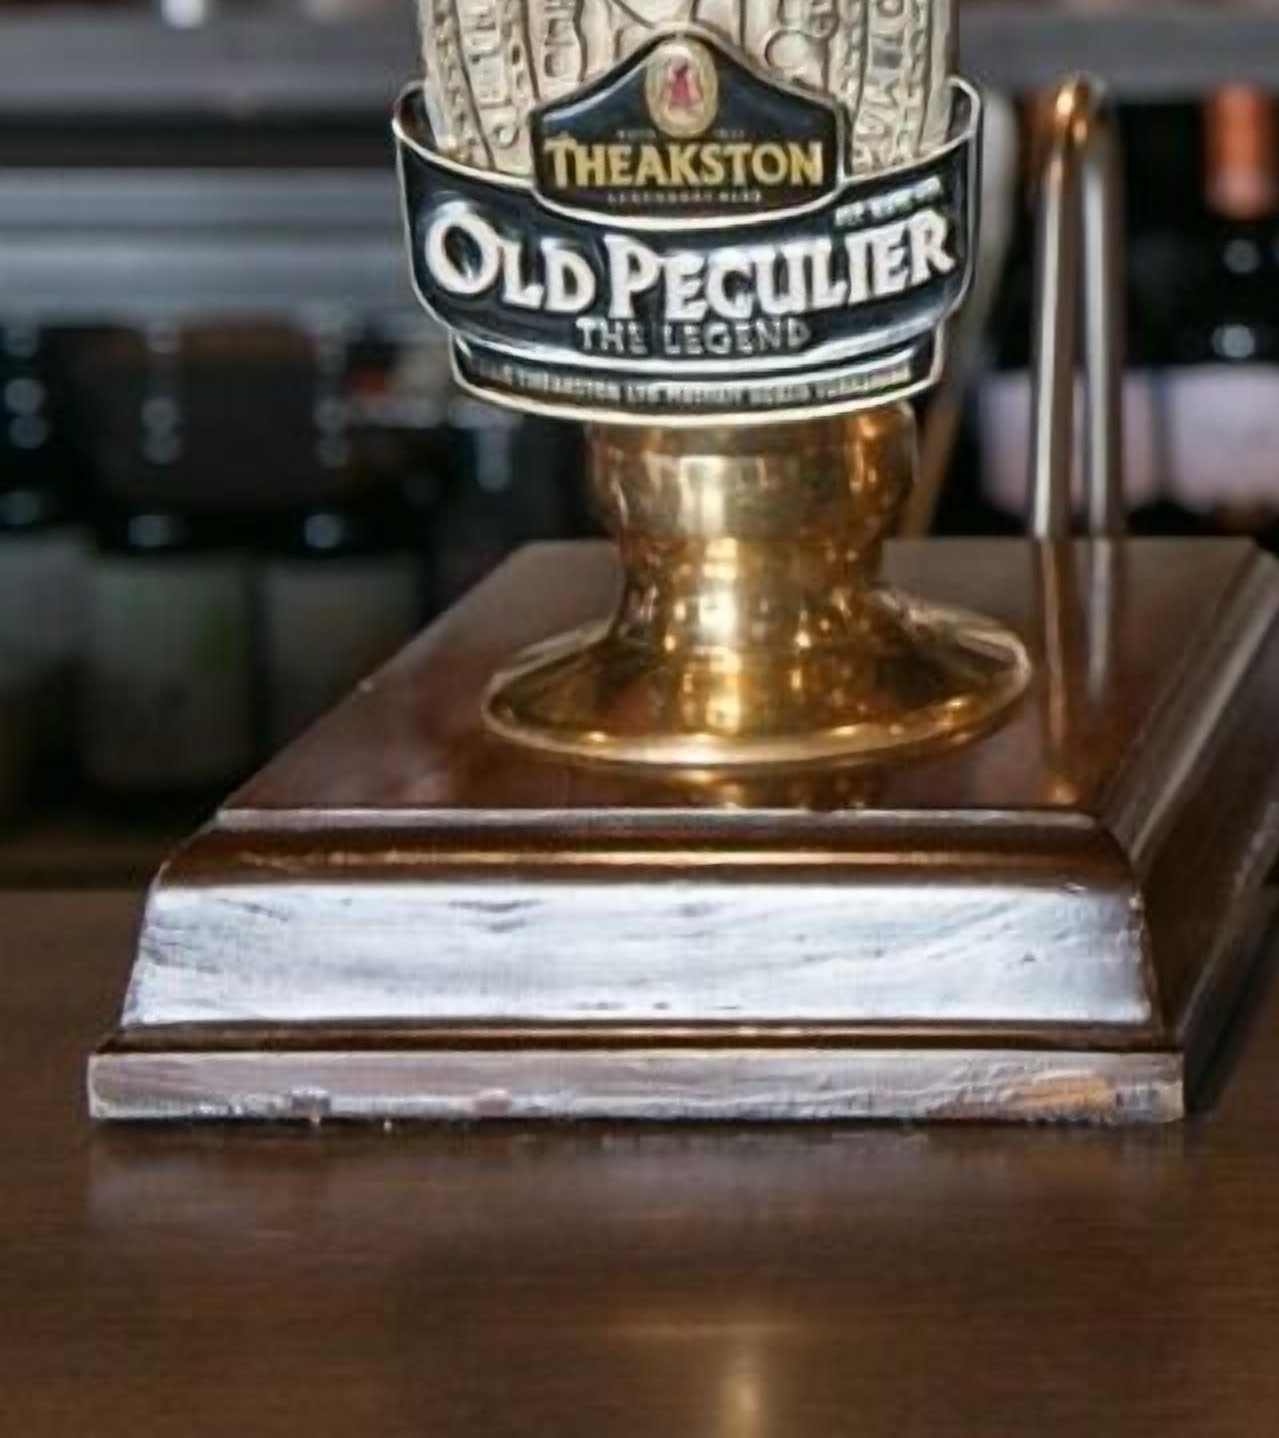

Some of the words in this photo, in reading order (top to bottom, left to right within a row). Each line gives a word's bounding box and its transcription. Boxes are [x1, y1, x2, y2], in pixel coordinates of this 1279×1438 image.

[543, 134, 824, 189] THEAKSTON
[424, 199, 597, 314] OLD
[602, 207, 957, 321] PECULIER
[574, 315, 649, 355] THE
[663, 317, 812, 356] LEGEND
